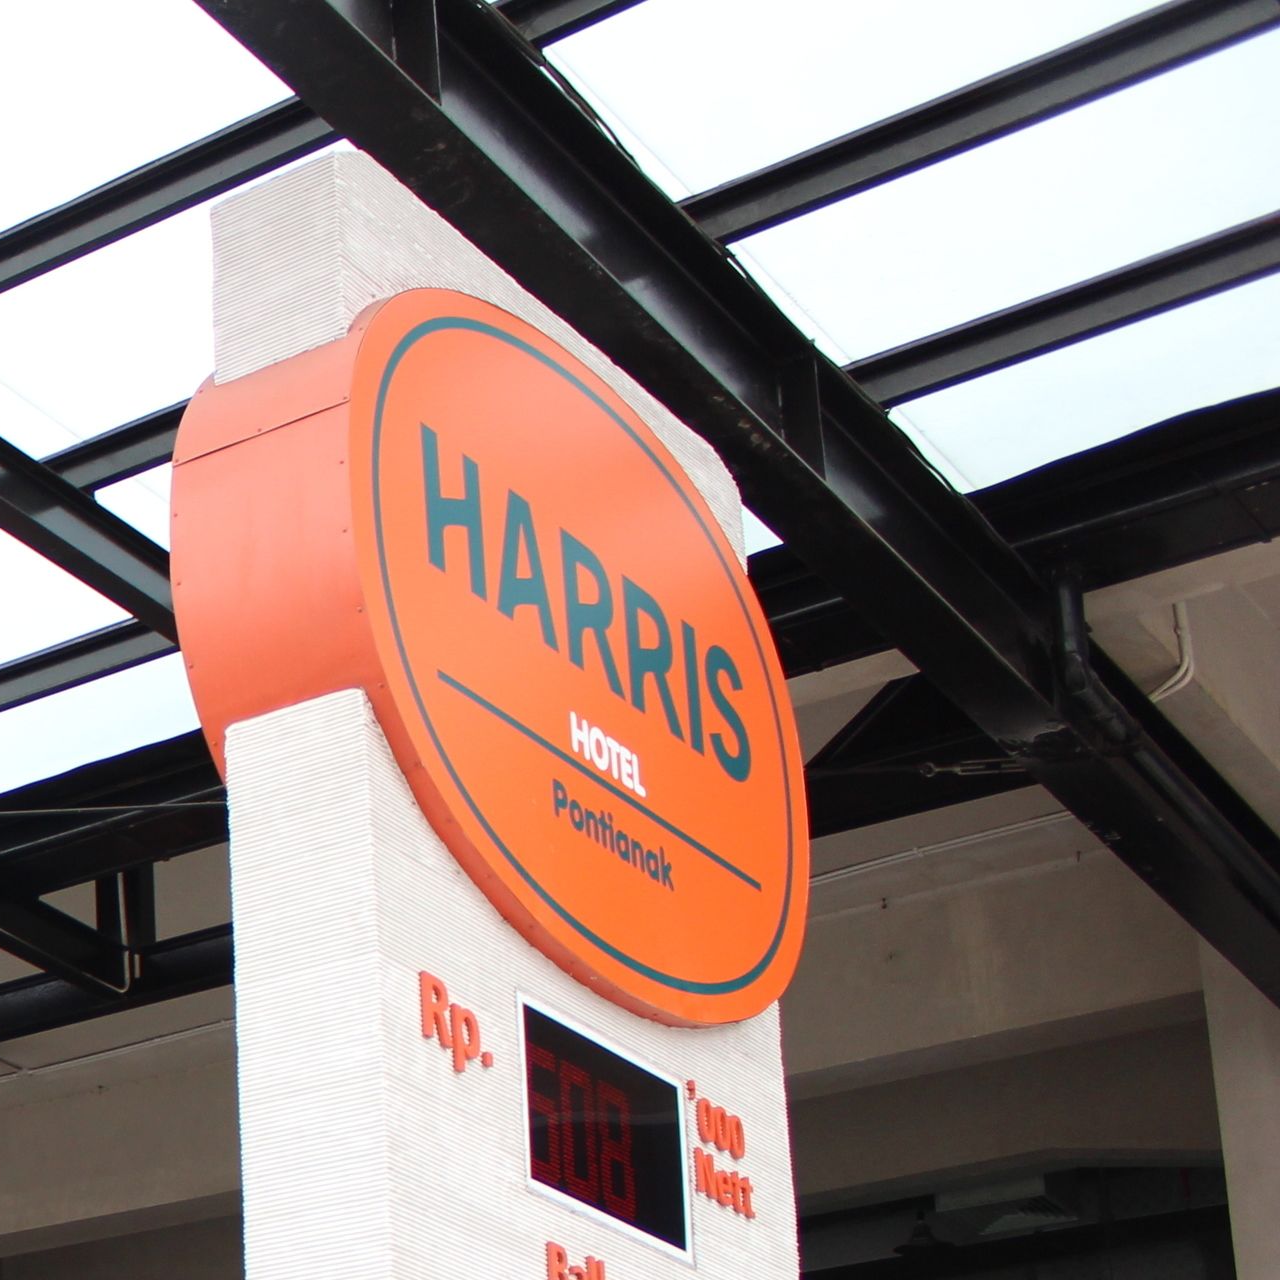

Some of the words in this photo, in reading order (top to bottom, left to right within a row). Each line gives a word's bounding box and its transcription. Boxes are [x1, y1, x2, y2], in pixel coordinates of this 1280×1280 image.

[420, 421, 752, 784] HARRIS
[569, 711, 646, 797] HOTEL
[552, 779, 674, 891] Pontianak
[419, 970, 493, 1072] Rp.
[693, 1146, 756, 1220] Nett
